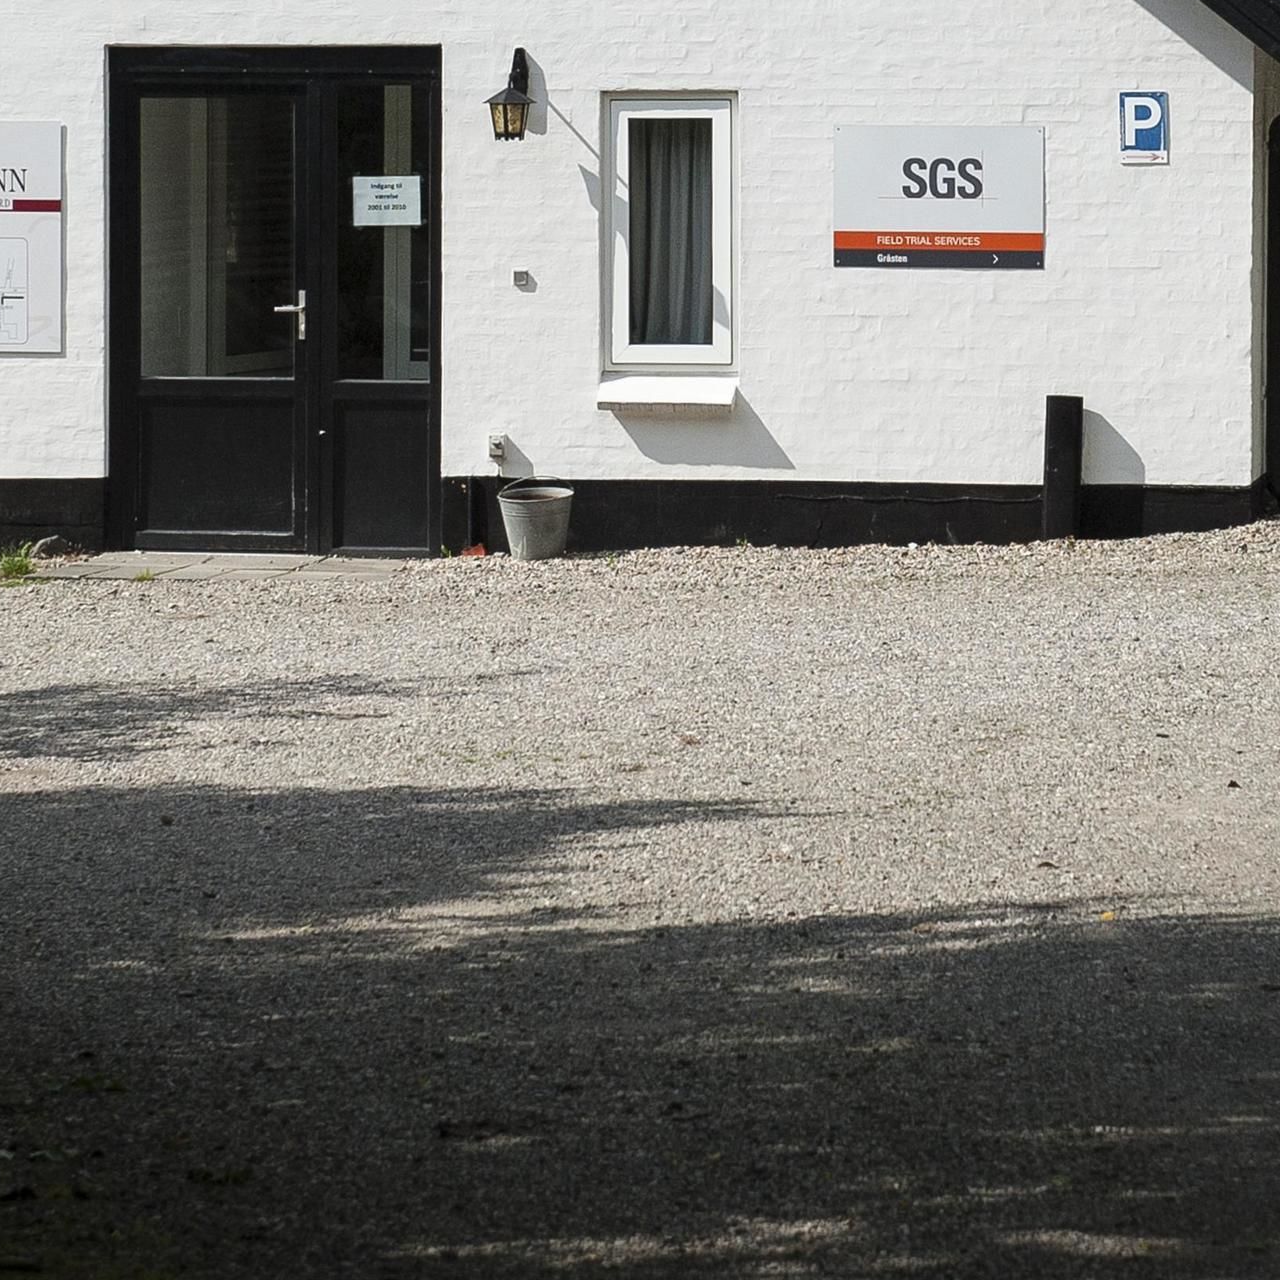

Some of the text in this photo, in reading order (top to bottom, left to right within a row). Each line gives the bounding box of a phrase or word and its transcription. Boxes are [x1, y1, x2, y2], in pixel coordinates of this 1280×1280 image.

[1124, 97, 1162, 146] P
[902, 158, 983, 199] SGS
[876, 235, 981, 247] FIELD TRIAL SERVICES
[876, 253, 909, 263] Gråsten
